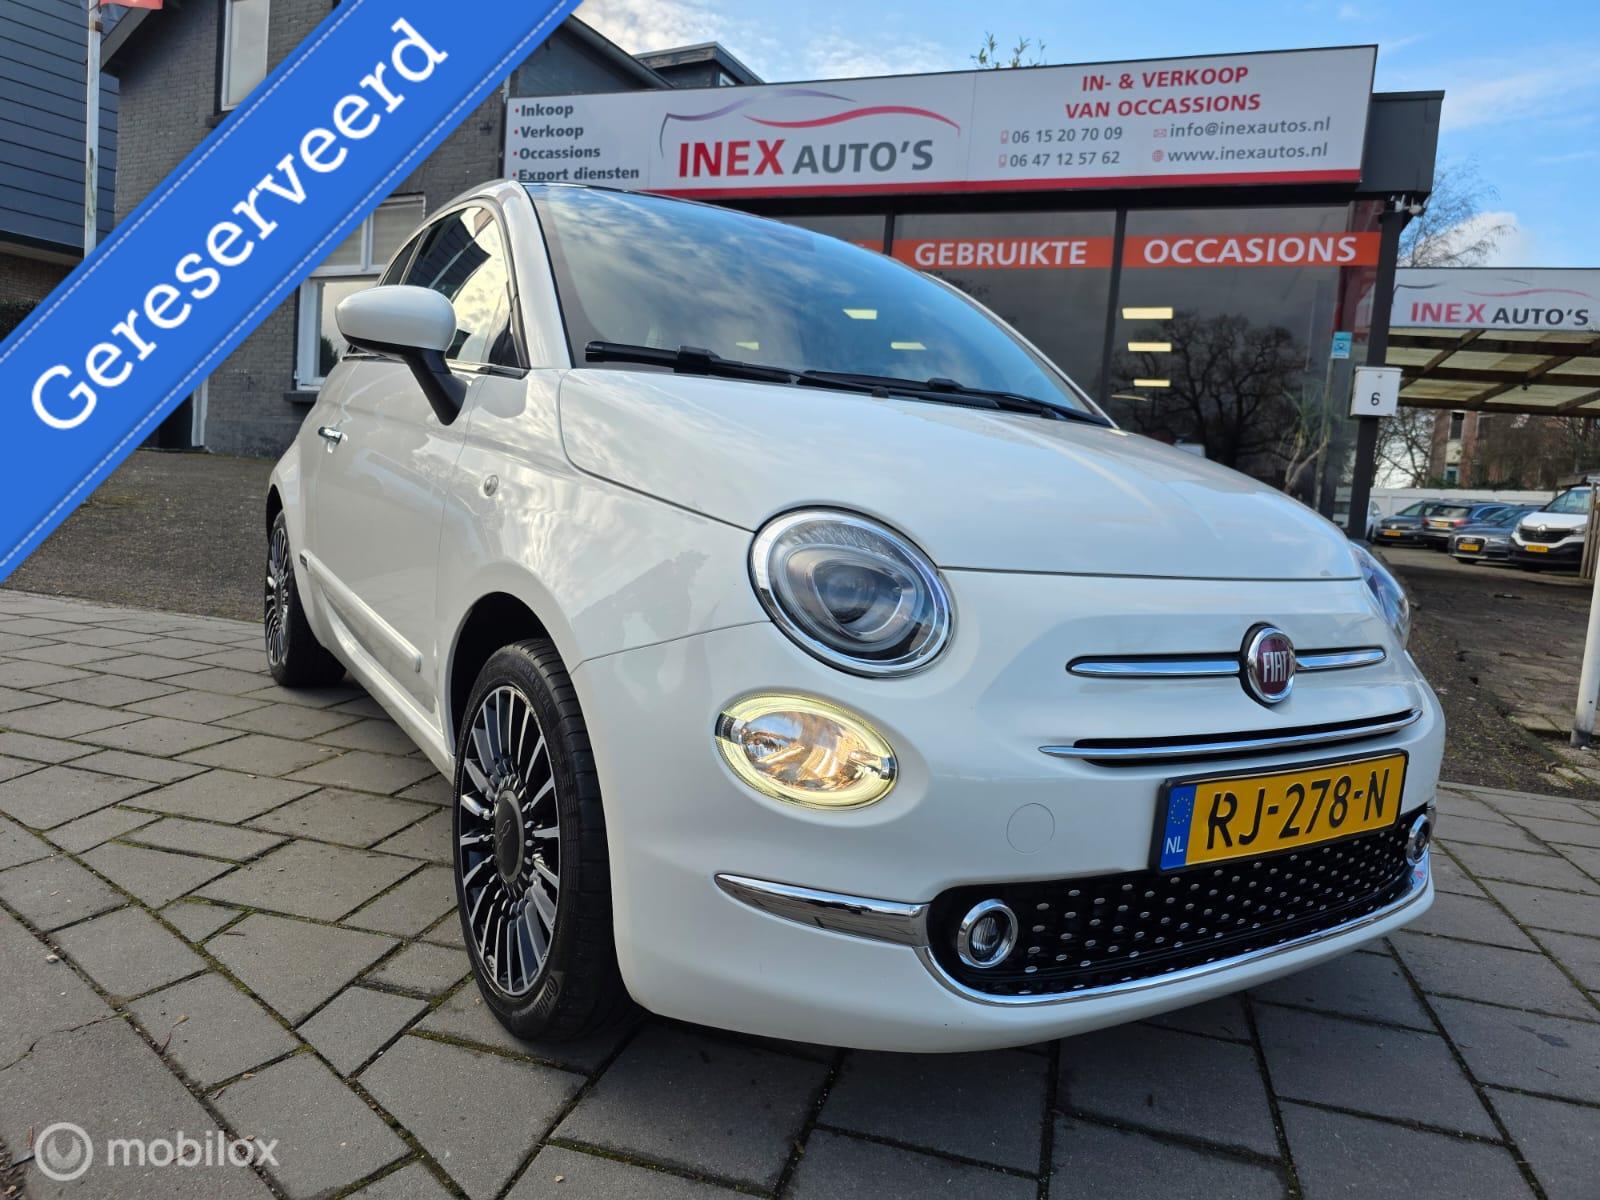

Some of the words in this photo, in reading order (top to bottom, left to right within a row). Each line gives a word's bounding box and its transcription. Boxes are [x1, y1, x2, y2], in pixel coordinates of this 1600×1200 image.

[1081, 74, 1112, 92] IN-
[1118, 74, 1134, 90] &
[1141, 66, 1249, 88] VERKOOP
[520, 104, 574, 118] Inkoop
[1065, 102, 1110, 119] VAN
[1117, 94, 1262, 117] OCCASSIONS
[520, 126, 584, 139] Verkoop
[1011, 130, 1030, 144] 06
[1035, 129, 1053, 144] 15
[1057, 128, 1077, 143] 20
[1080, 127, 1099, 142] 70
[1103, 126, 1123, 141] 09
[1169, 116, 1331, 138] info@inexautos.nl
[519, 146, 600, 160] Occassions
[679, 139, 785, 177] INEX
[792, 140, 933, 174] AUTO'S
[1009, 154, 1028, 167] 06
[1032, 153, 1050, 167] 47
[1055, 152, 1074, 166] 12
[1078, 151, 1097, 165] 57
[1102, 150, 1121, 165] 62
[1167, 142, 1328, 163] www.inexautos.nl
[518, 168, 569, 181] Export
[573, 166, 639, 179] diensten
[914, 240, 1088, 266] GEBRUIKTE
[1143, 236, 1357, 264] OCCASIONS
[1410, 302, 1486, 323] INEX
[1491, 307, 1589, 326] AUTO'S
[1370, 391, 1381, 406] 6
[1262, 650, 1289, 683] FIAT
[1206, 768, 1390, 850] RJ-278-N
[1165, 836, 1184, 854] NL
